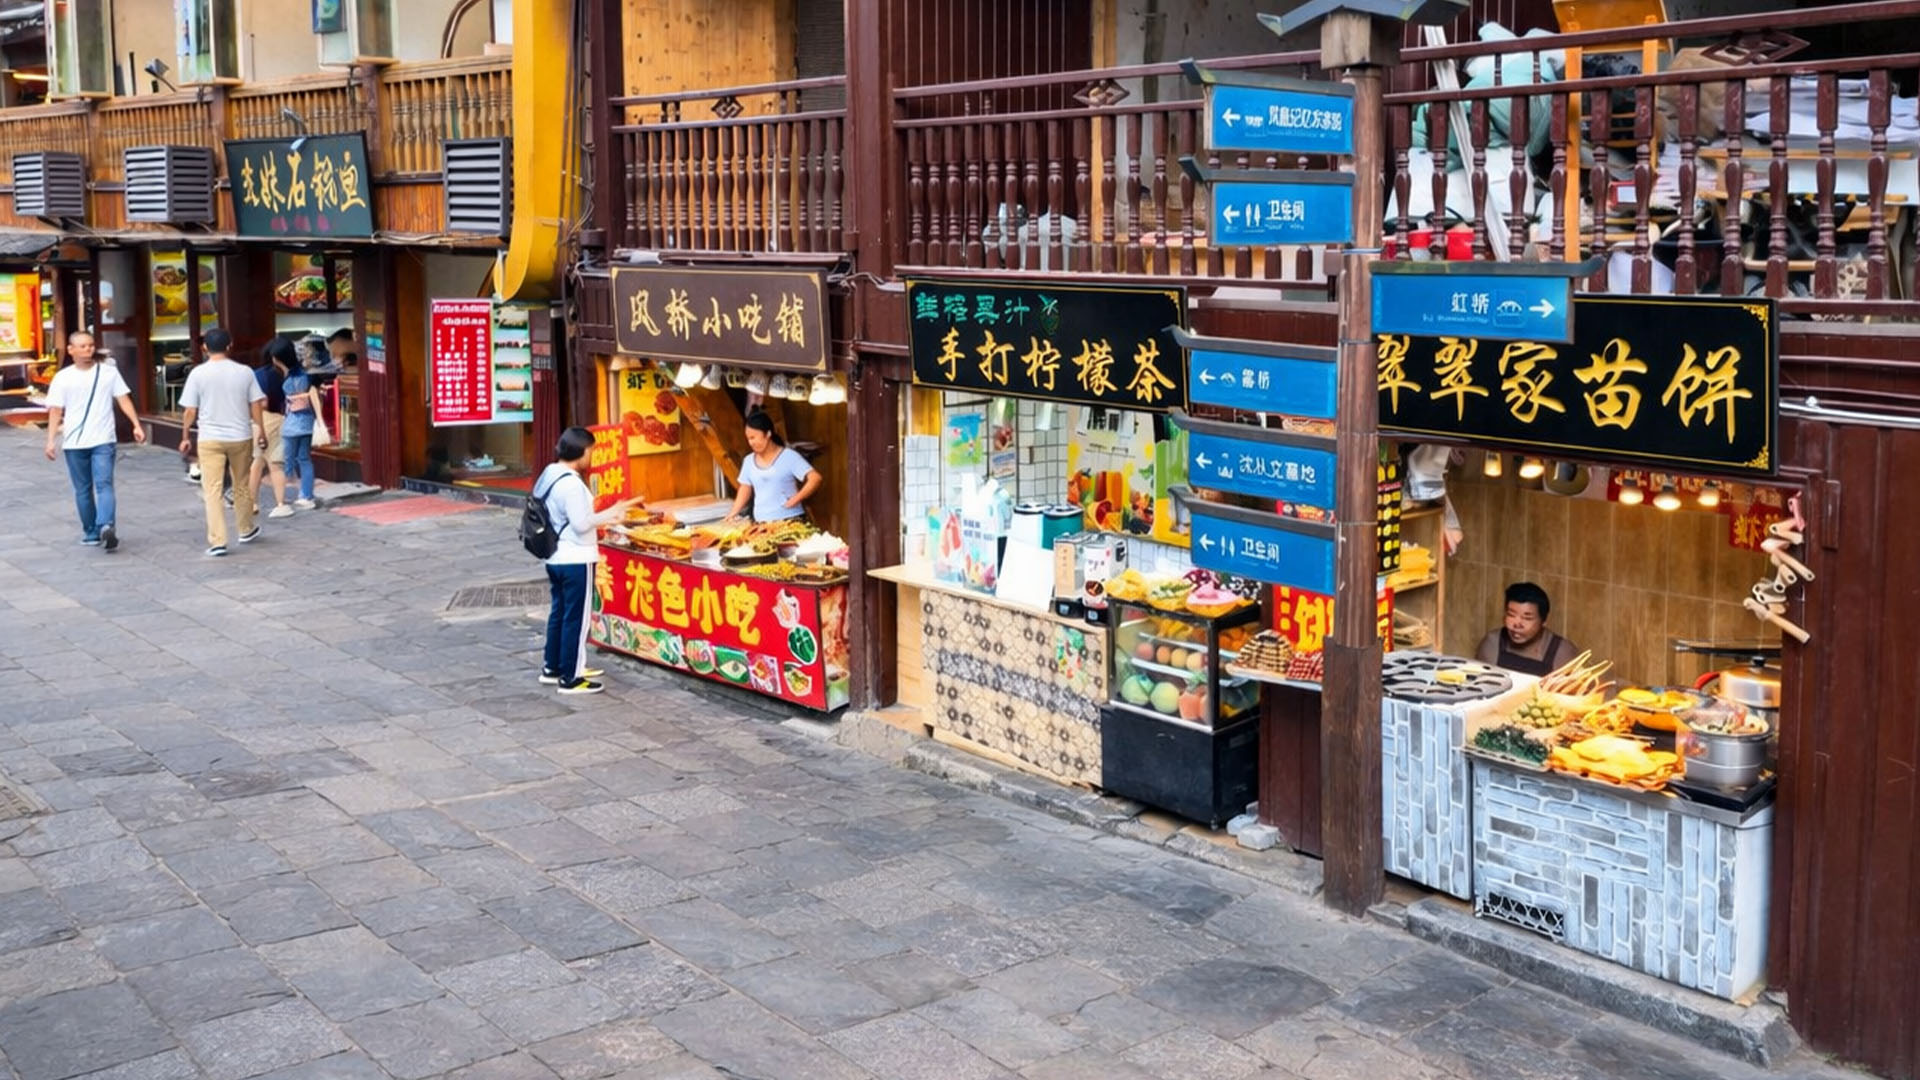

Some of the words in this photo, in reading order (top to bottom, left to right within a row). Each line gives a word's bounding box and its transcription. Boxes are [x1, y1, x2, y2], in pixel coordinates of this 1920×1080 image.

[1266, 200, 1304, 221] 卫生间
[937, 326, 1176, 402] 手打柠檬茶
[1378, 334, 1753, 445] 翠翠家苗饼
[1241, 537, 1280, 563] 卫生间
